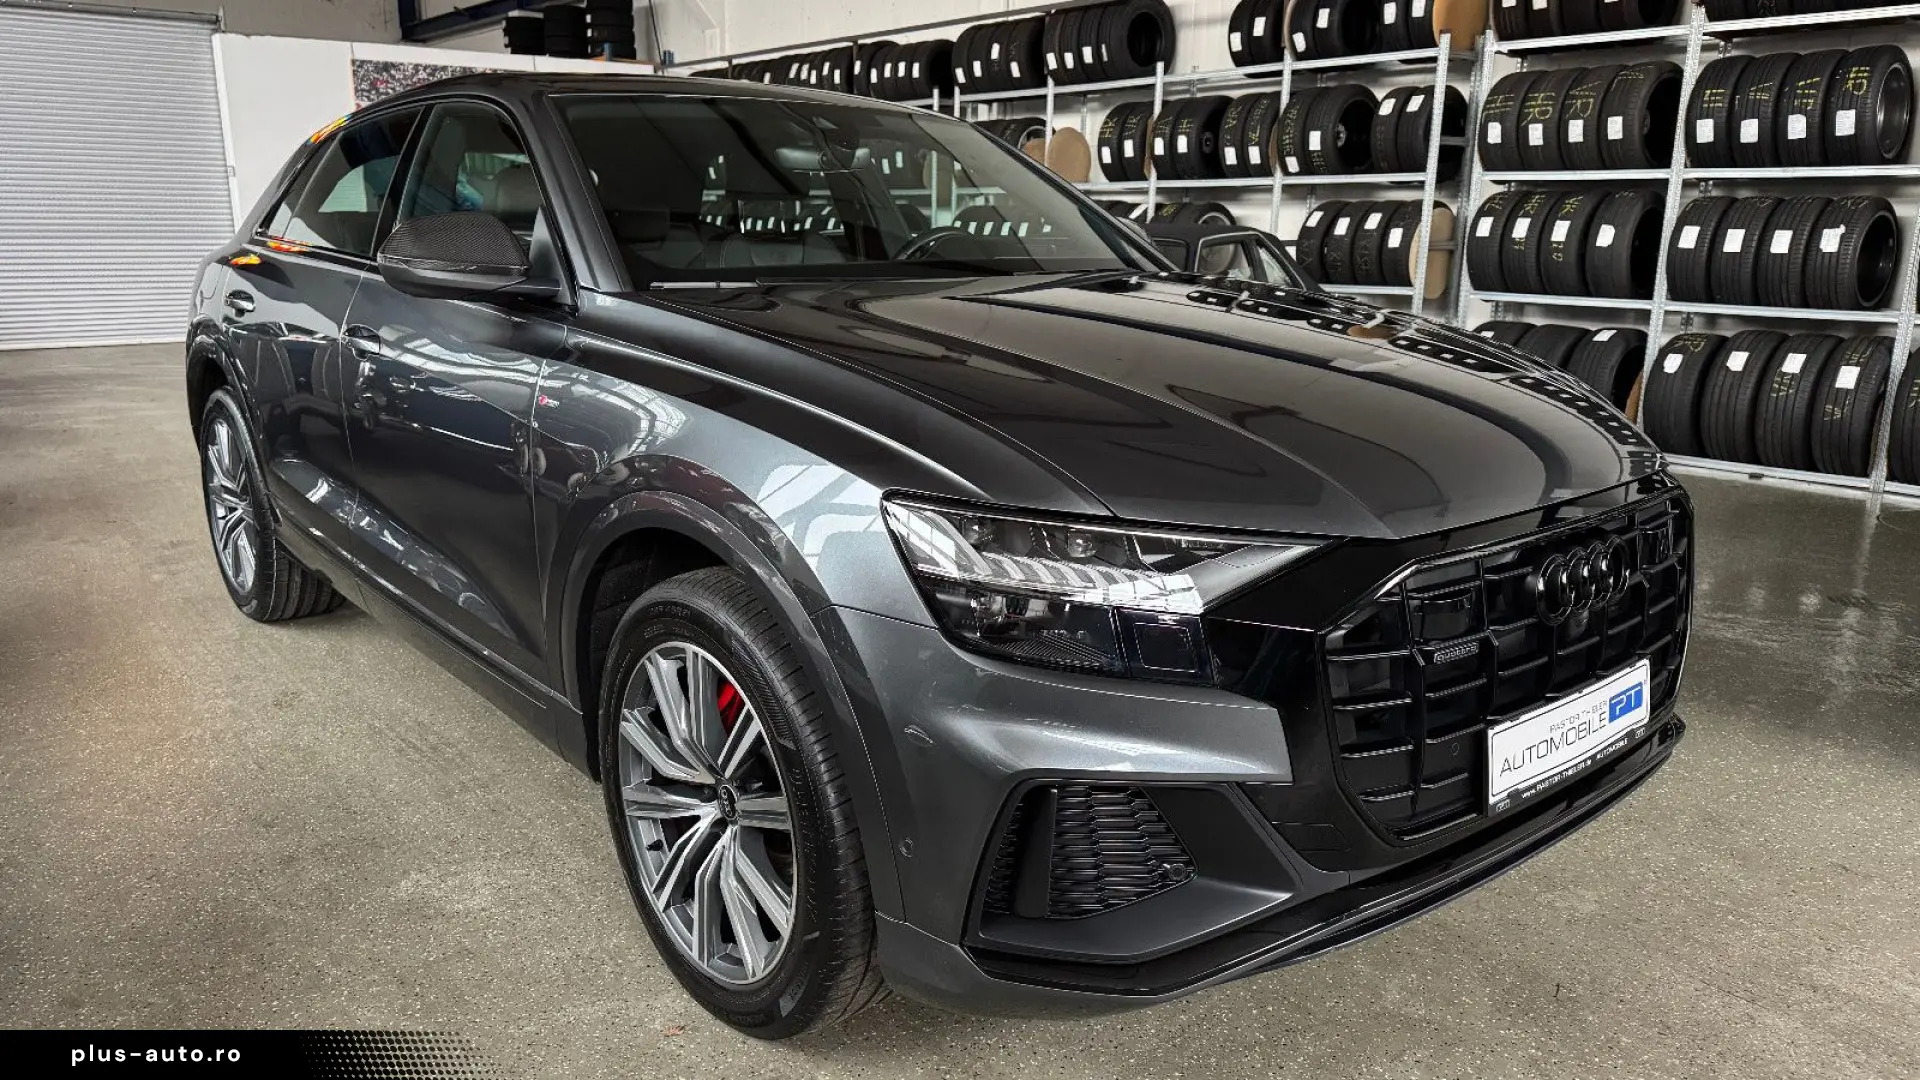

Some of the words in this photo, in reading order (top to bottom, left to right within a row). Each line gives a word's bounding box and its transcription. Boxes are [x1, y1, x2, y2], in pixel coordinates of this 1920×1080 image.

[1520, 91, 1556, 127] HR
[1565, 81, 1601, 119] VR
[1611, 686, 1641, 716] PT
[1500, 710, 1607, 777] AUTOMOBILE
